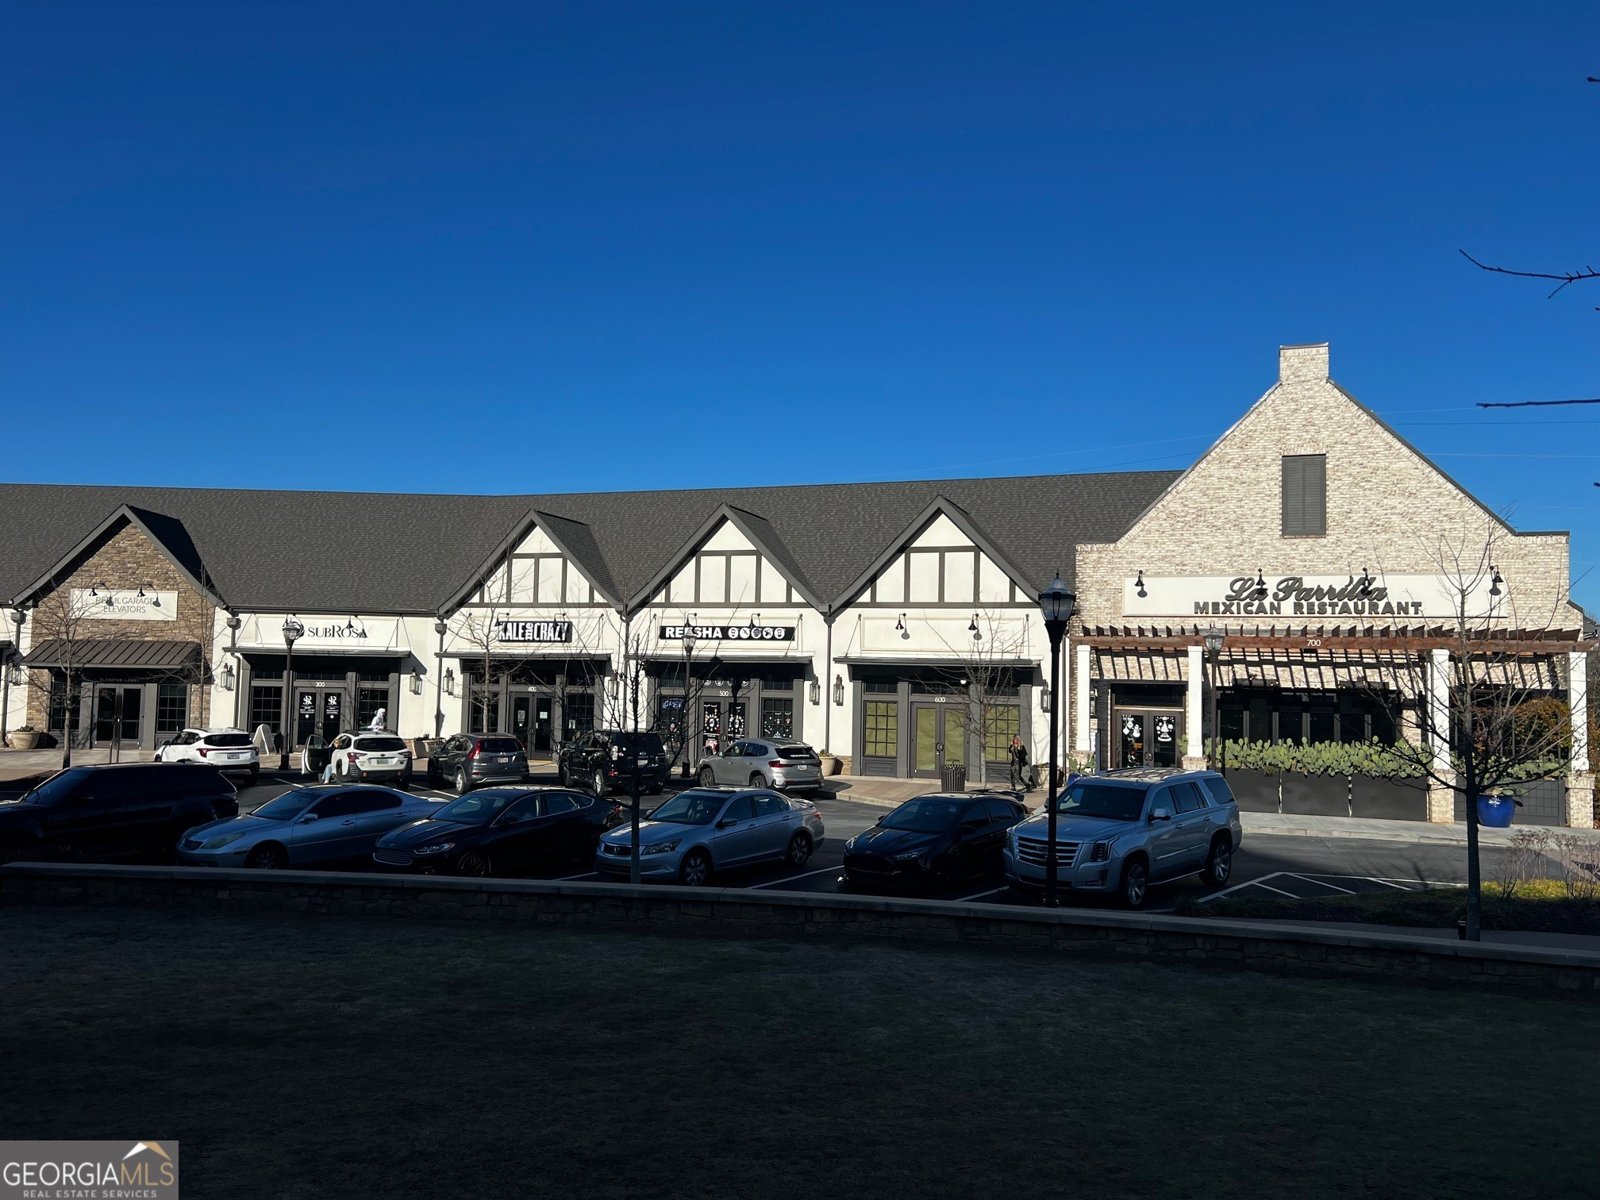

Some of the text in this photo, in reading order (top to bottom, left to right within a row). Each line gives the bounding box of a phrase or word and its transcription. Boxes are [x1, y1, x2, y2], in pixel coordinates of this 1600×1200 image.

[1225, 576, 1388, 601] La Parrilla
[103, 605, 146, 613] ELEVATORS
[1194, 601, 1423, 615] MEXICAN RESTAURANT
[498, 622, 525, 641] KALE
[534, 622, 569, 641] CRAZY
